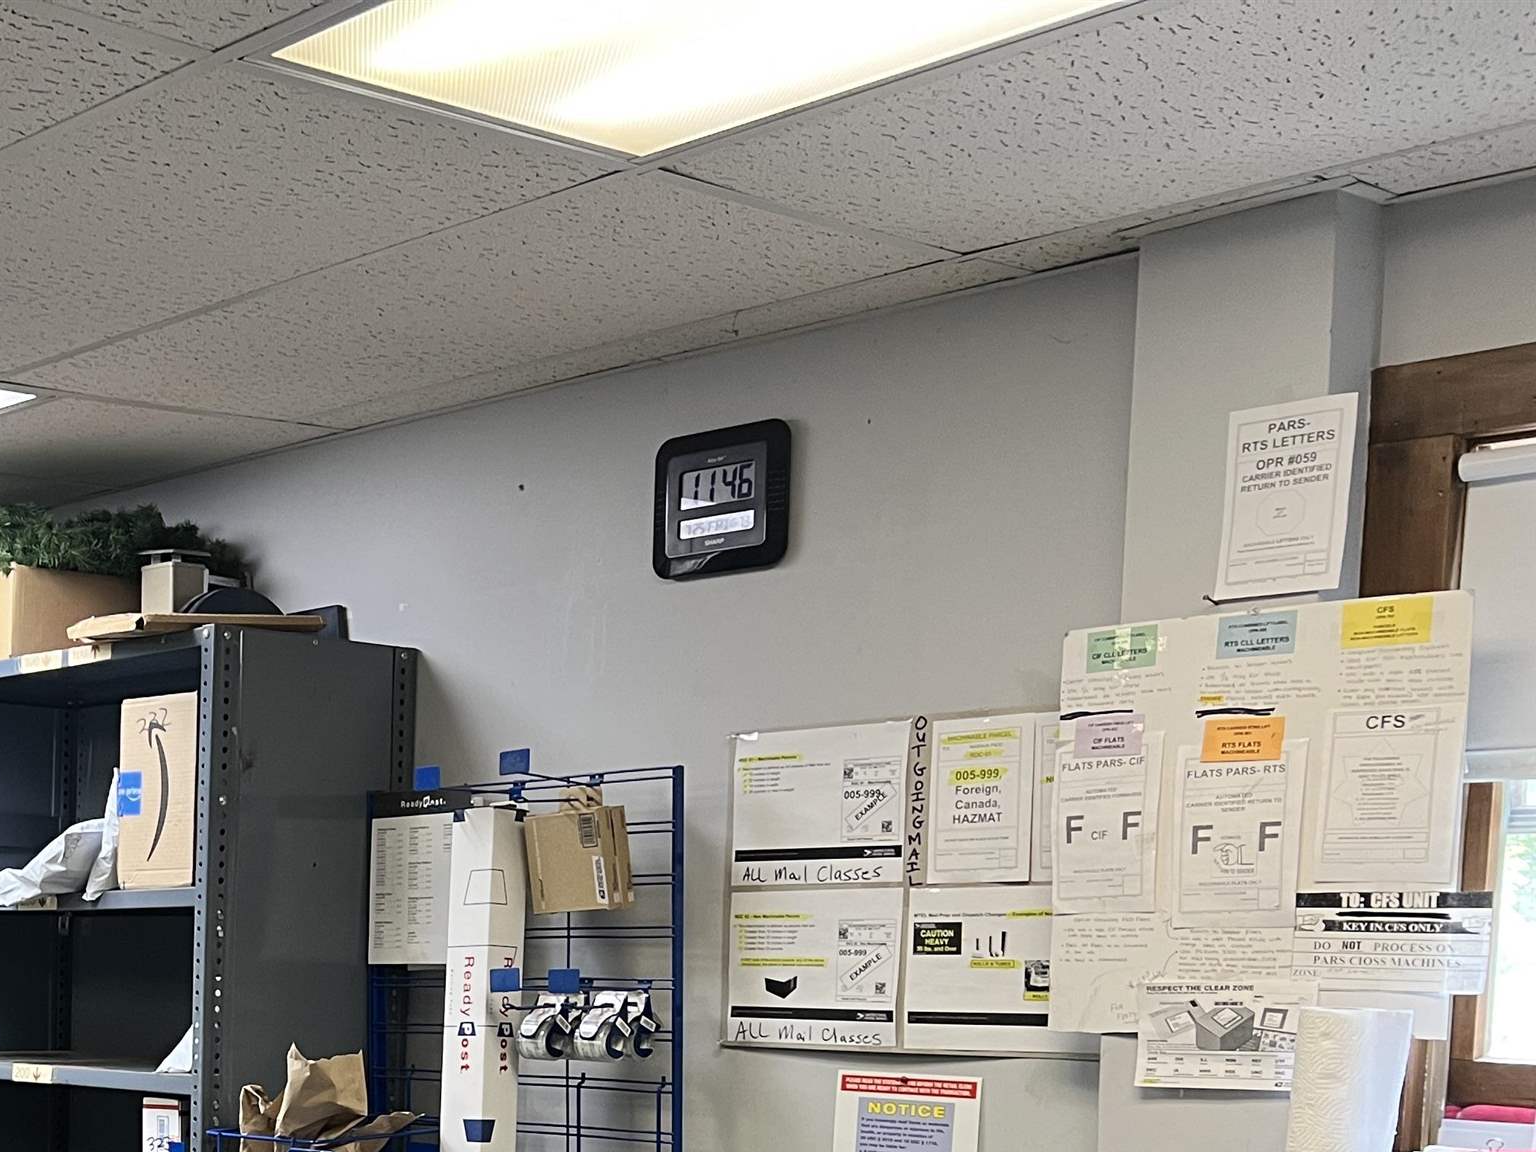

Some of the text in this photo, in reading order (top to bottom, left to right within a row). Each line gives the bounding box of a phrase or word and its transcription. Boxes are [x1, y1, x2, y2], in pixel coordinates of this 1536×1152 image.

[1267, 417, 1311, 434] PARS-
[1241, 428, 1336, 454] RTS LETTERS
[1255, 451, 1318, 471] OPR #059
[1241, 462, 1333, 484] CARRIER IDENTIFIED
[1240, 473, 1330, 493] RETURN TO SENDER
[1375, 605, 1395, 614] CFS
[1256, 636, 1290, 645] LETTERS
[1365, 714, 1406, 730] CFS
[1104, 735, 1125, 744] FLATS
[1221, 740, 1262, 749] RTS FLATS
[1061, 760, 1094, 772] FLATS
[1128, 756, 1145, 767] CIF
[1186, 768, 1223, 779] FLATS
[1263, 763, 1286, 774] RTS
[955, 784, 1002, 796] Foreign,
[854, 792, 888, 822] EXAMPLE
[954, 799, 1001, 810] Canada,
[952, 812, 1003, 824] HAZMAT
[1065, 810, 1142, 844] F CIF F
[1191, 824, 1214, 855] F
[1258, 820, 1282, 852] F
[774, 864, 808, 882] Mail
[816, 865, 883, 883] Classes
[1340, 892, 1441, 909] TO: CFS UNIT
[920, 929, 954, 938] CAUTION
[1342, 921, 1367, 932] KEY
[1384, 923, 1407, 932] CFS
[1408, 923, 1444, 933] ONLY
[924, 938, 950, 946] HEAVY
[1313, 940, 1331, 951] DO
[1341, 940, 1362, 950] NOT
[1373, 942, 1433, 953] PROCESS
[849, 952, 883, 981] EXAMPLE
[1313, 955, 1346, 965] PARS
[1232, 984, 1255, 992] ZONE
[778, 1025, 812, 1041] Mail
[821, 1027, 882, 1045] Classes
[867, 1101, 945, 1118] NOTICE
